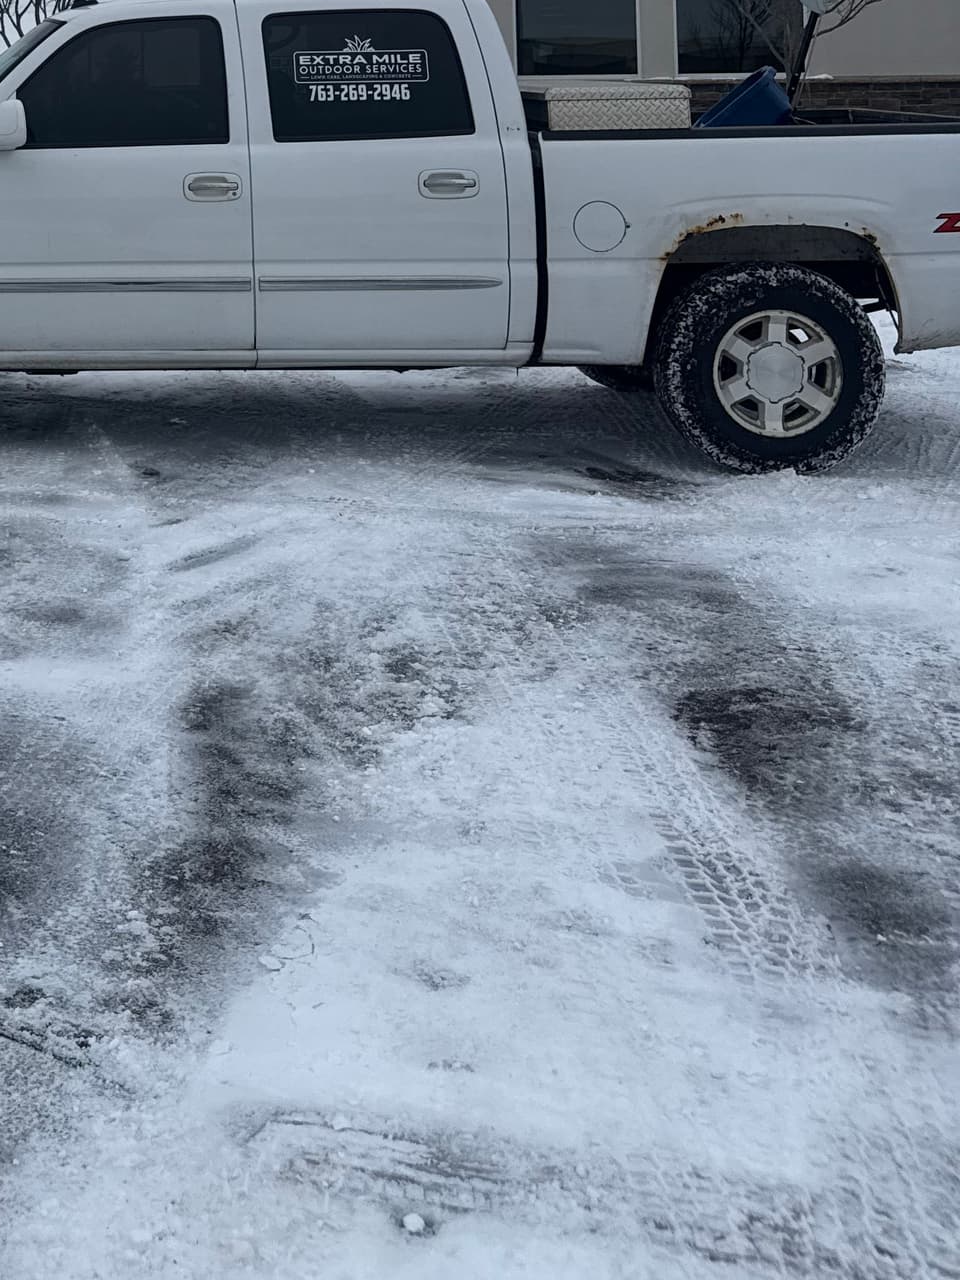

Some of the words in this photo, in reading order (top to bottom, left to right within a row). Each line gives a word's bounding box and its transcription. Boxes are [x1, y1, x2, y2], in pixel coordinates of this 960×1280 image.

[299, 55, 368, 65] EXTRA
[372, 54, 422, 64] MILE
[299, 65, 361, 74] OUTDOOR
[366, 64, 422, 73] SERVICES
[309, 83, 411, 102] 763-269-2946
